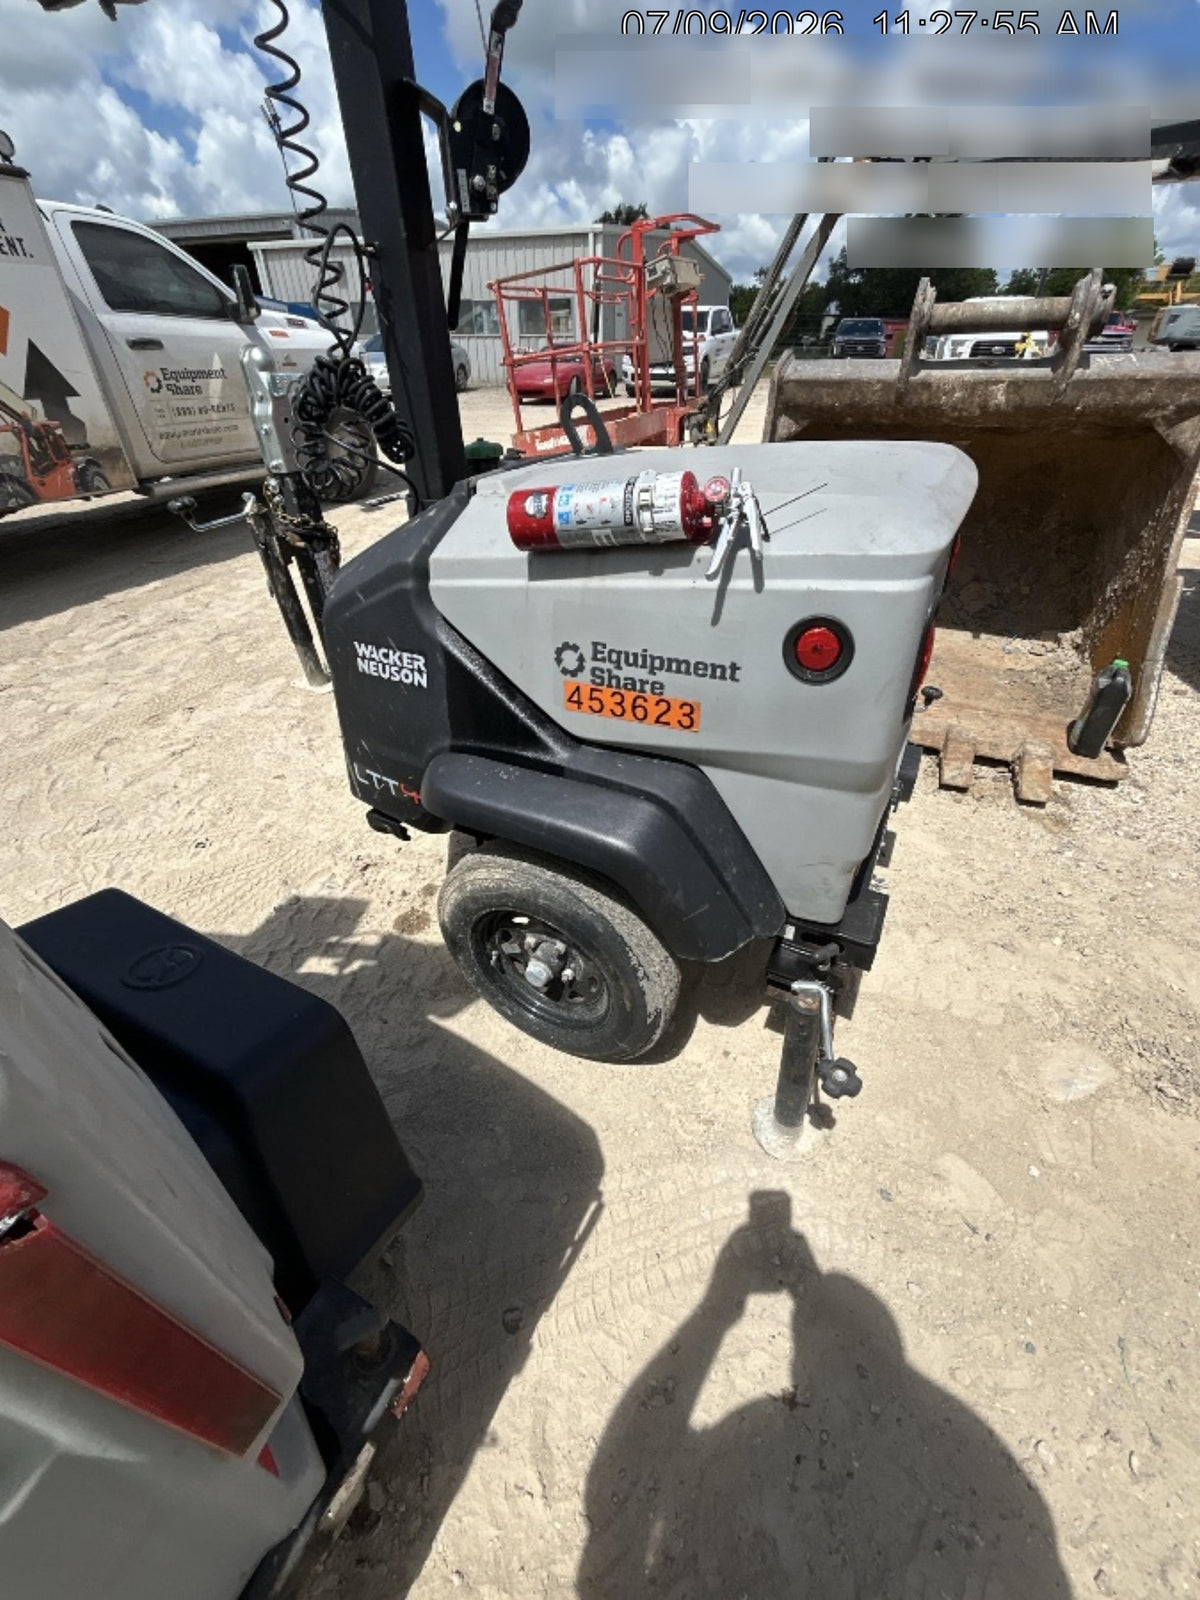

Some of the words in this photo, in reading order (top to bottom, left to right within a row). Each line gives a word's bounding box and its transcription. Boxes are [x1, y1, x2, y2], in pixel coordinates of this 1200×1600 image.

[160, 367, 228, 383] Equipment
[165, 383, 203, 396] Share
[353, 641, 427, 674] WACKER
[356, 657, 428, 689] NEUSON
[591, 641, 742, 682] Equipment
[590, 666, 665, 696] Share
[566, 685, 696, 730] 453623
